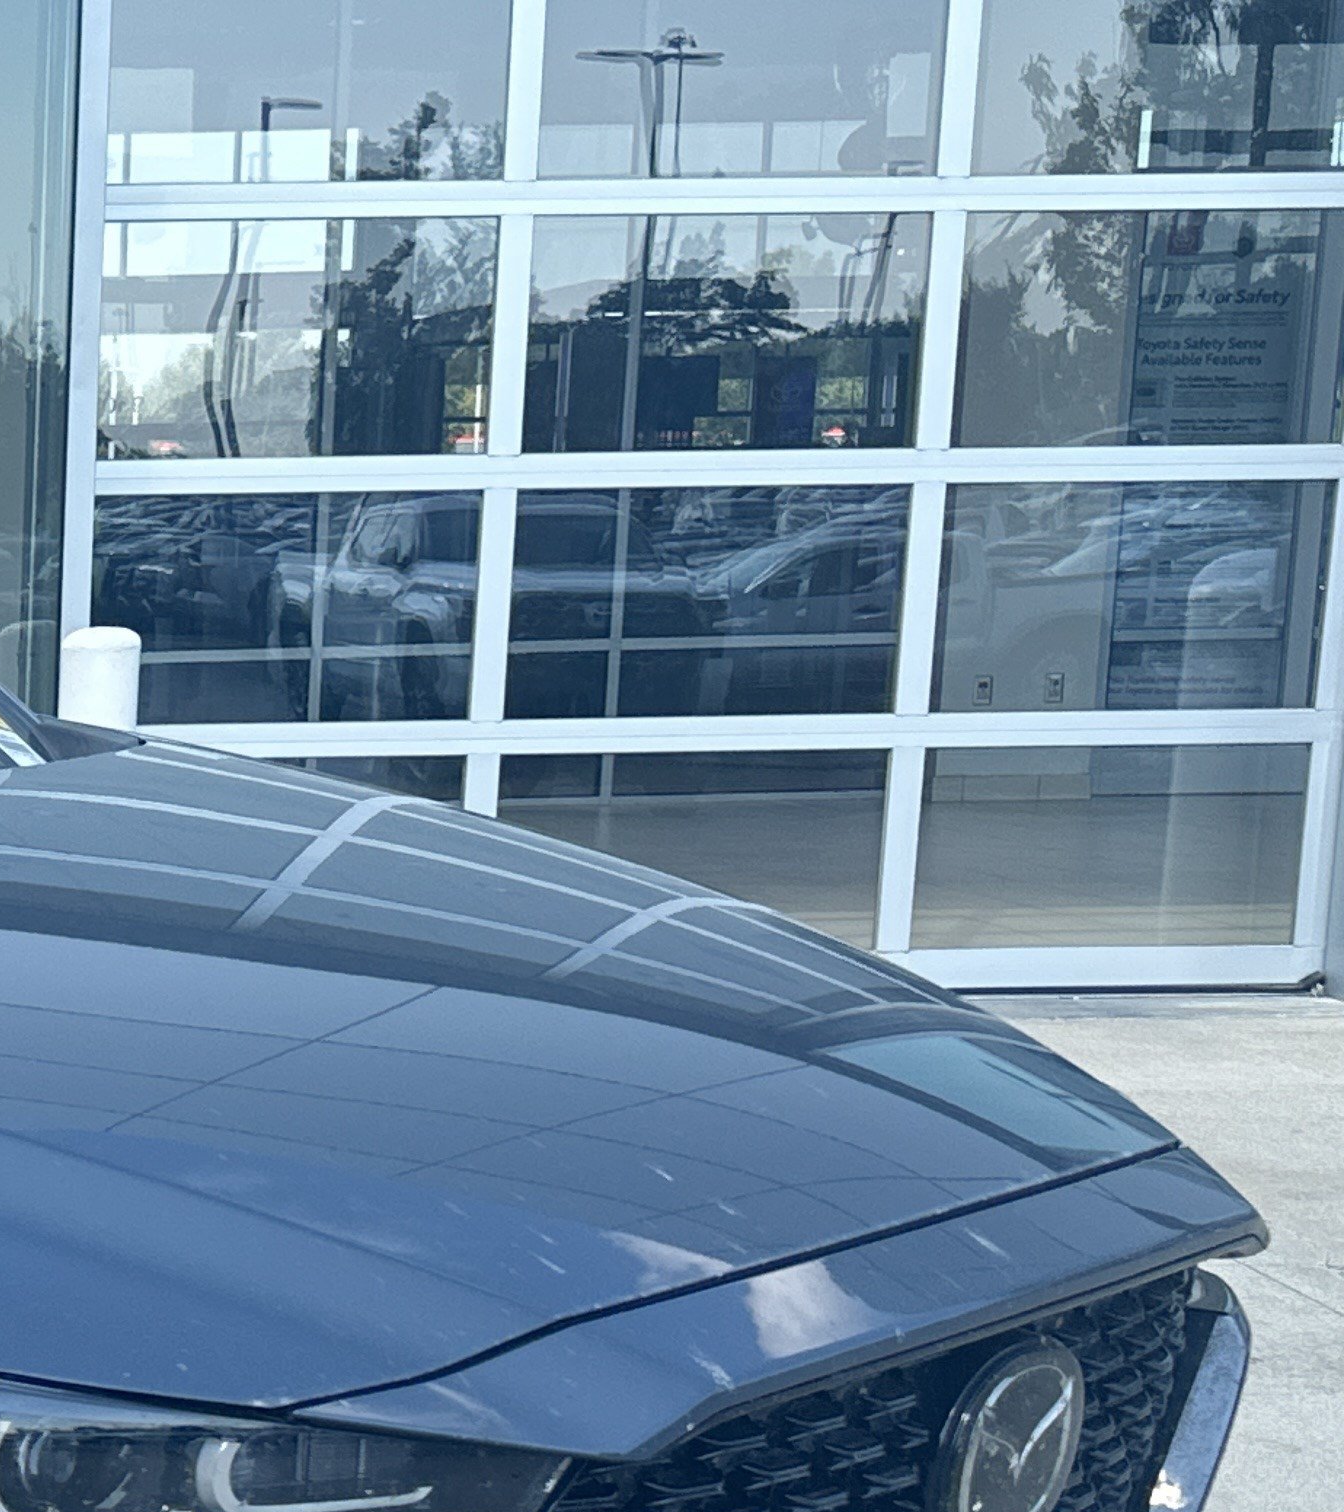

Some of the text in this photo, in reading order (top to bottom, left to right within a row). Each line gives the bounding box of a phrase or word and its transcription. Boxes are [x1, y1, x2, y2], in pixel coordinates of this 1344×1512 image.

[1236, 290, 1291, 307] Safety
[1183, 336, 1226, 353] Safety
[1228, 337, 1267, 350] Sense
[1206, 353, 1262, 366] Features
